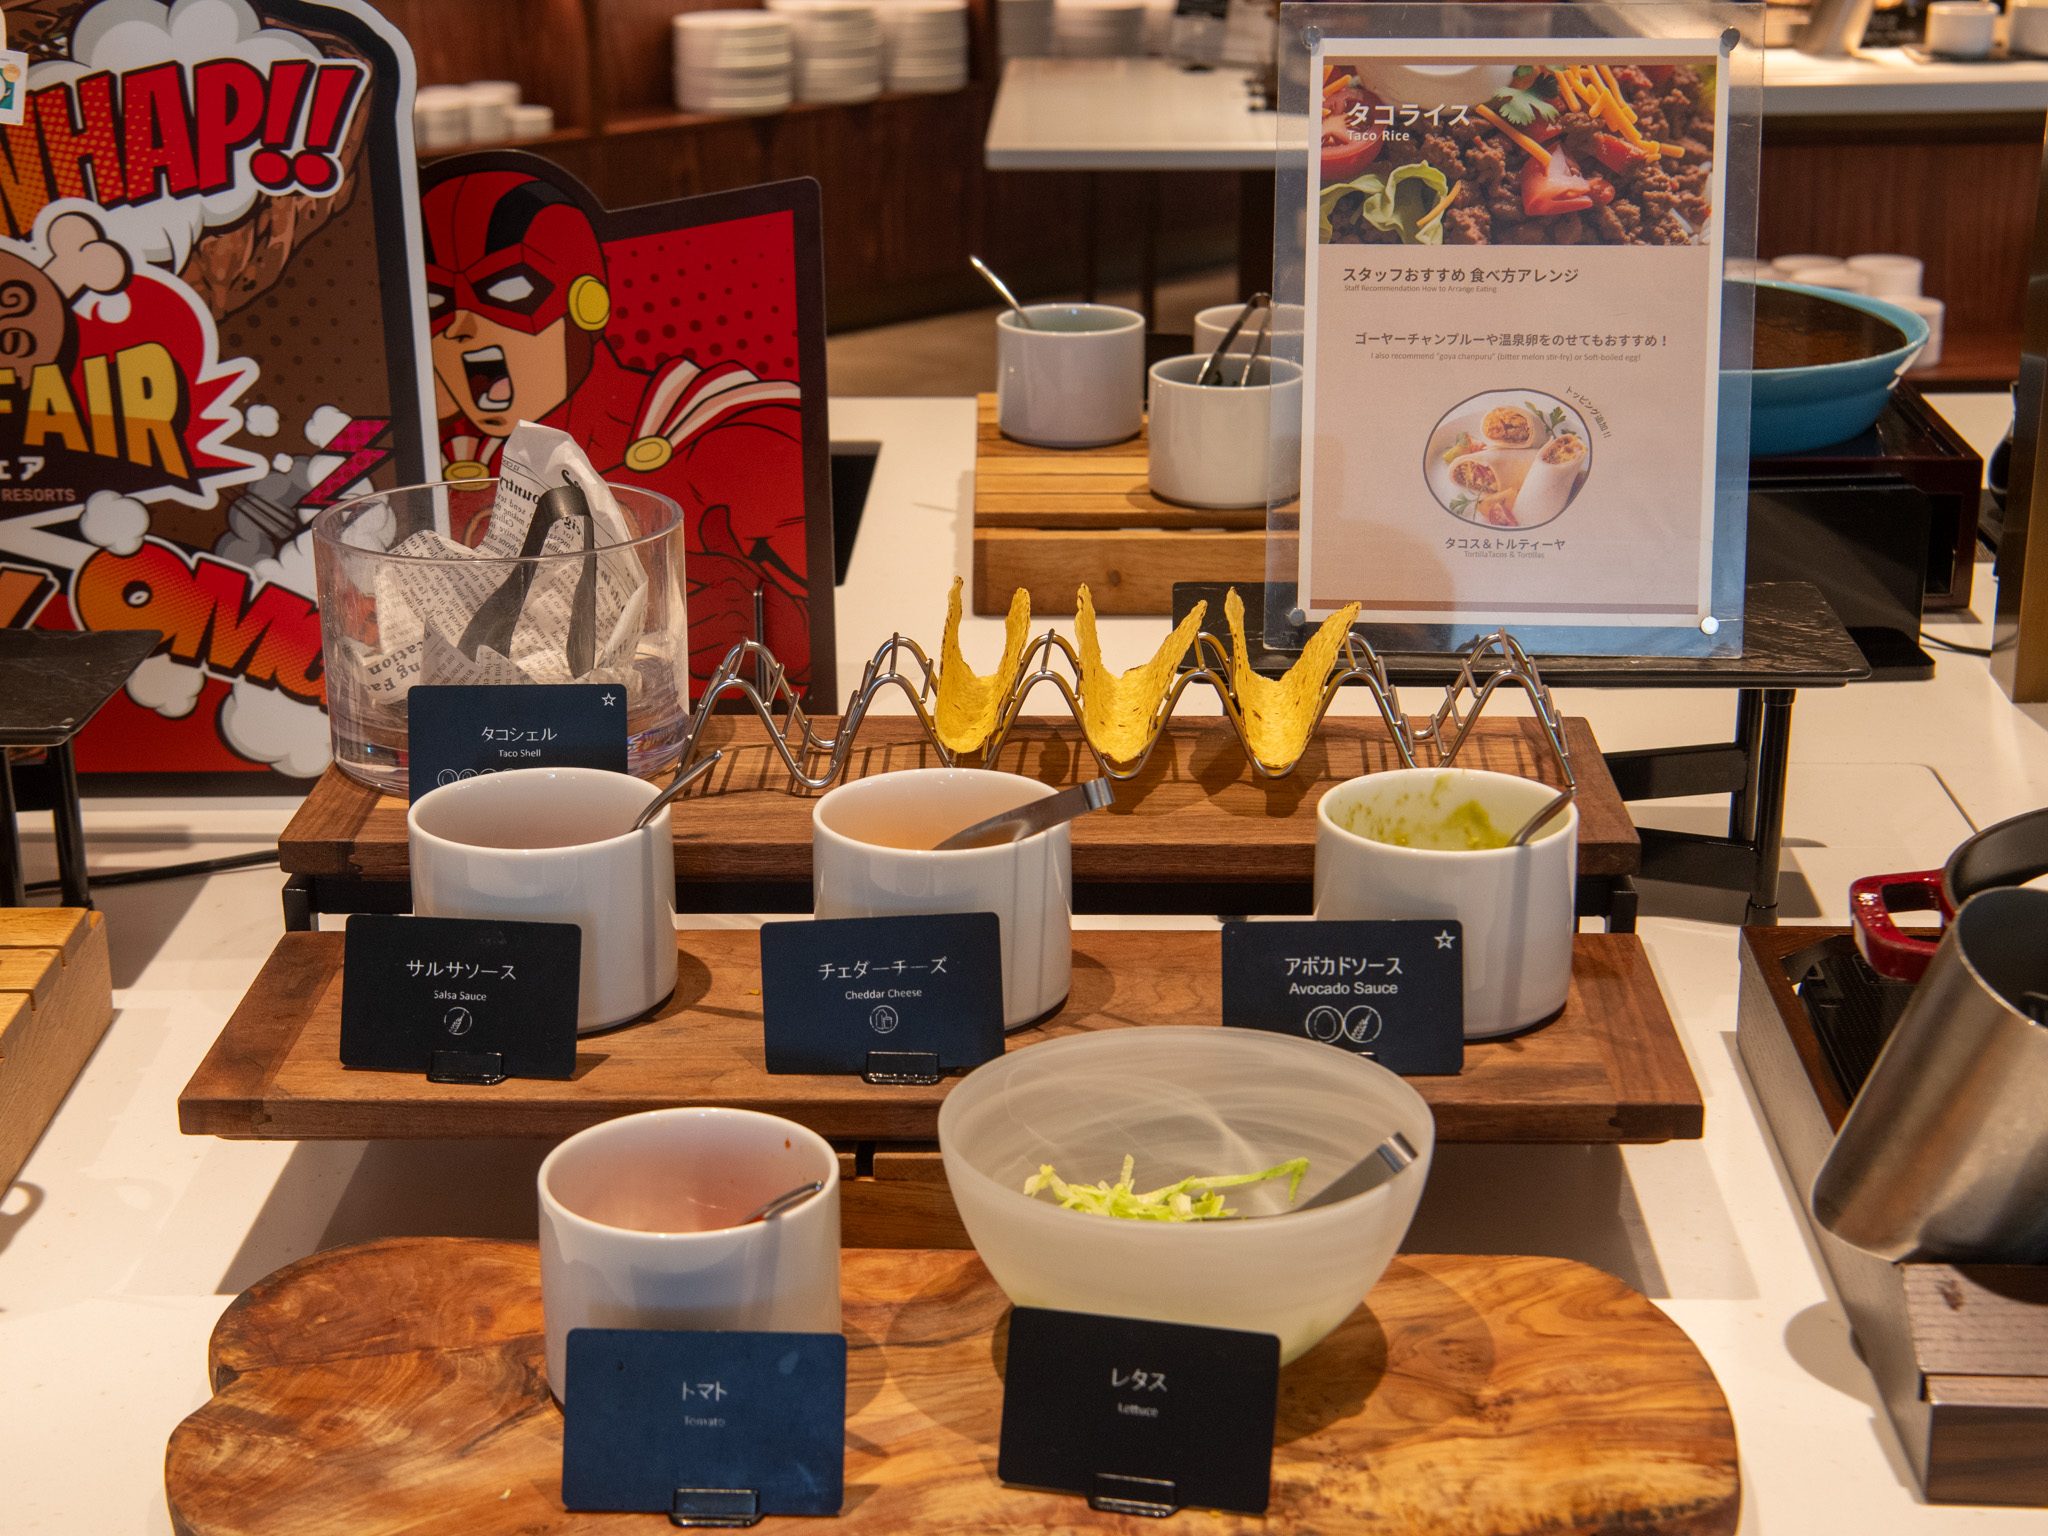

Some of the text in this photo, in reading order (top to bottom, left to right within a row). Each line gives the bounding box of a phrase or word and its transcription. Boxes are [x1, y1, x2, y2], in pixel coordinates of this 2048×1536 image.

[1348, 102, 1470, 126] タコライス
[1348, 130, 1410, 141] Taco Rice
[1343, 267, 1579, 283] スタッフおすすめ 食べ方アレンジ
[1344, 284, 1360, 292] Staff
[1447, 286, 1475, 294] Arrange
[1476, 286, 1497, 294] Eating
[1522, 353, 1545, 361] melon
[1, 487, 77, 503] RESORTS
[481, 726, 557, 742] タコシェル
[499, 749, 541, 758] Taco Shell
[406, 959, 516, 980] サルサソース
[818, 955, 948, 980] チェダーチーズ
[1284, 956, 1403, 976] アボカドソース
[433, 990, 487, 1001] Salsa Sauce
[845, 988, 923, 1000] Cheddar Cheese
[1289, 981, 1398, 995] Avocado Sauce
[1111, 1367, 1168, 1392] レタス
[682, 1380, 728, 1402] トマト
